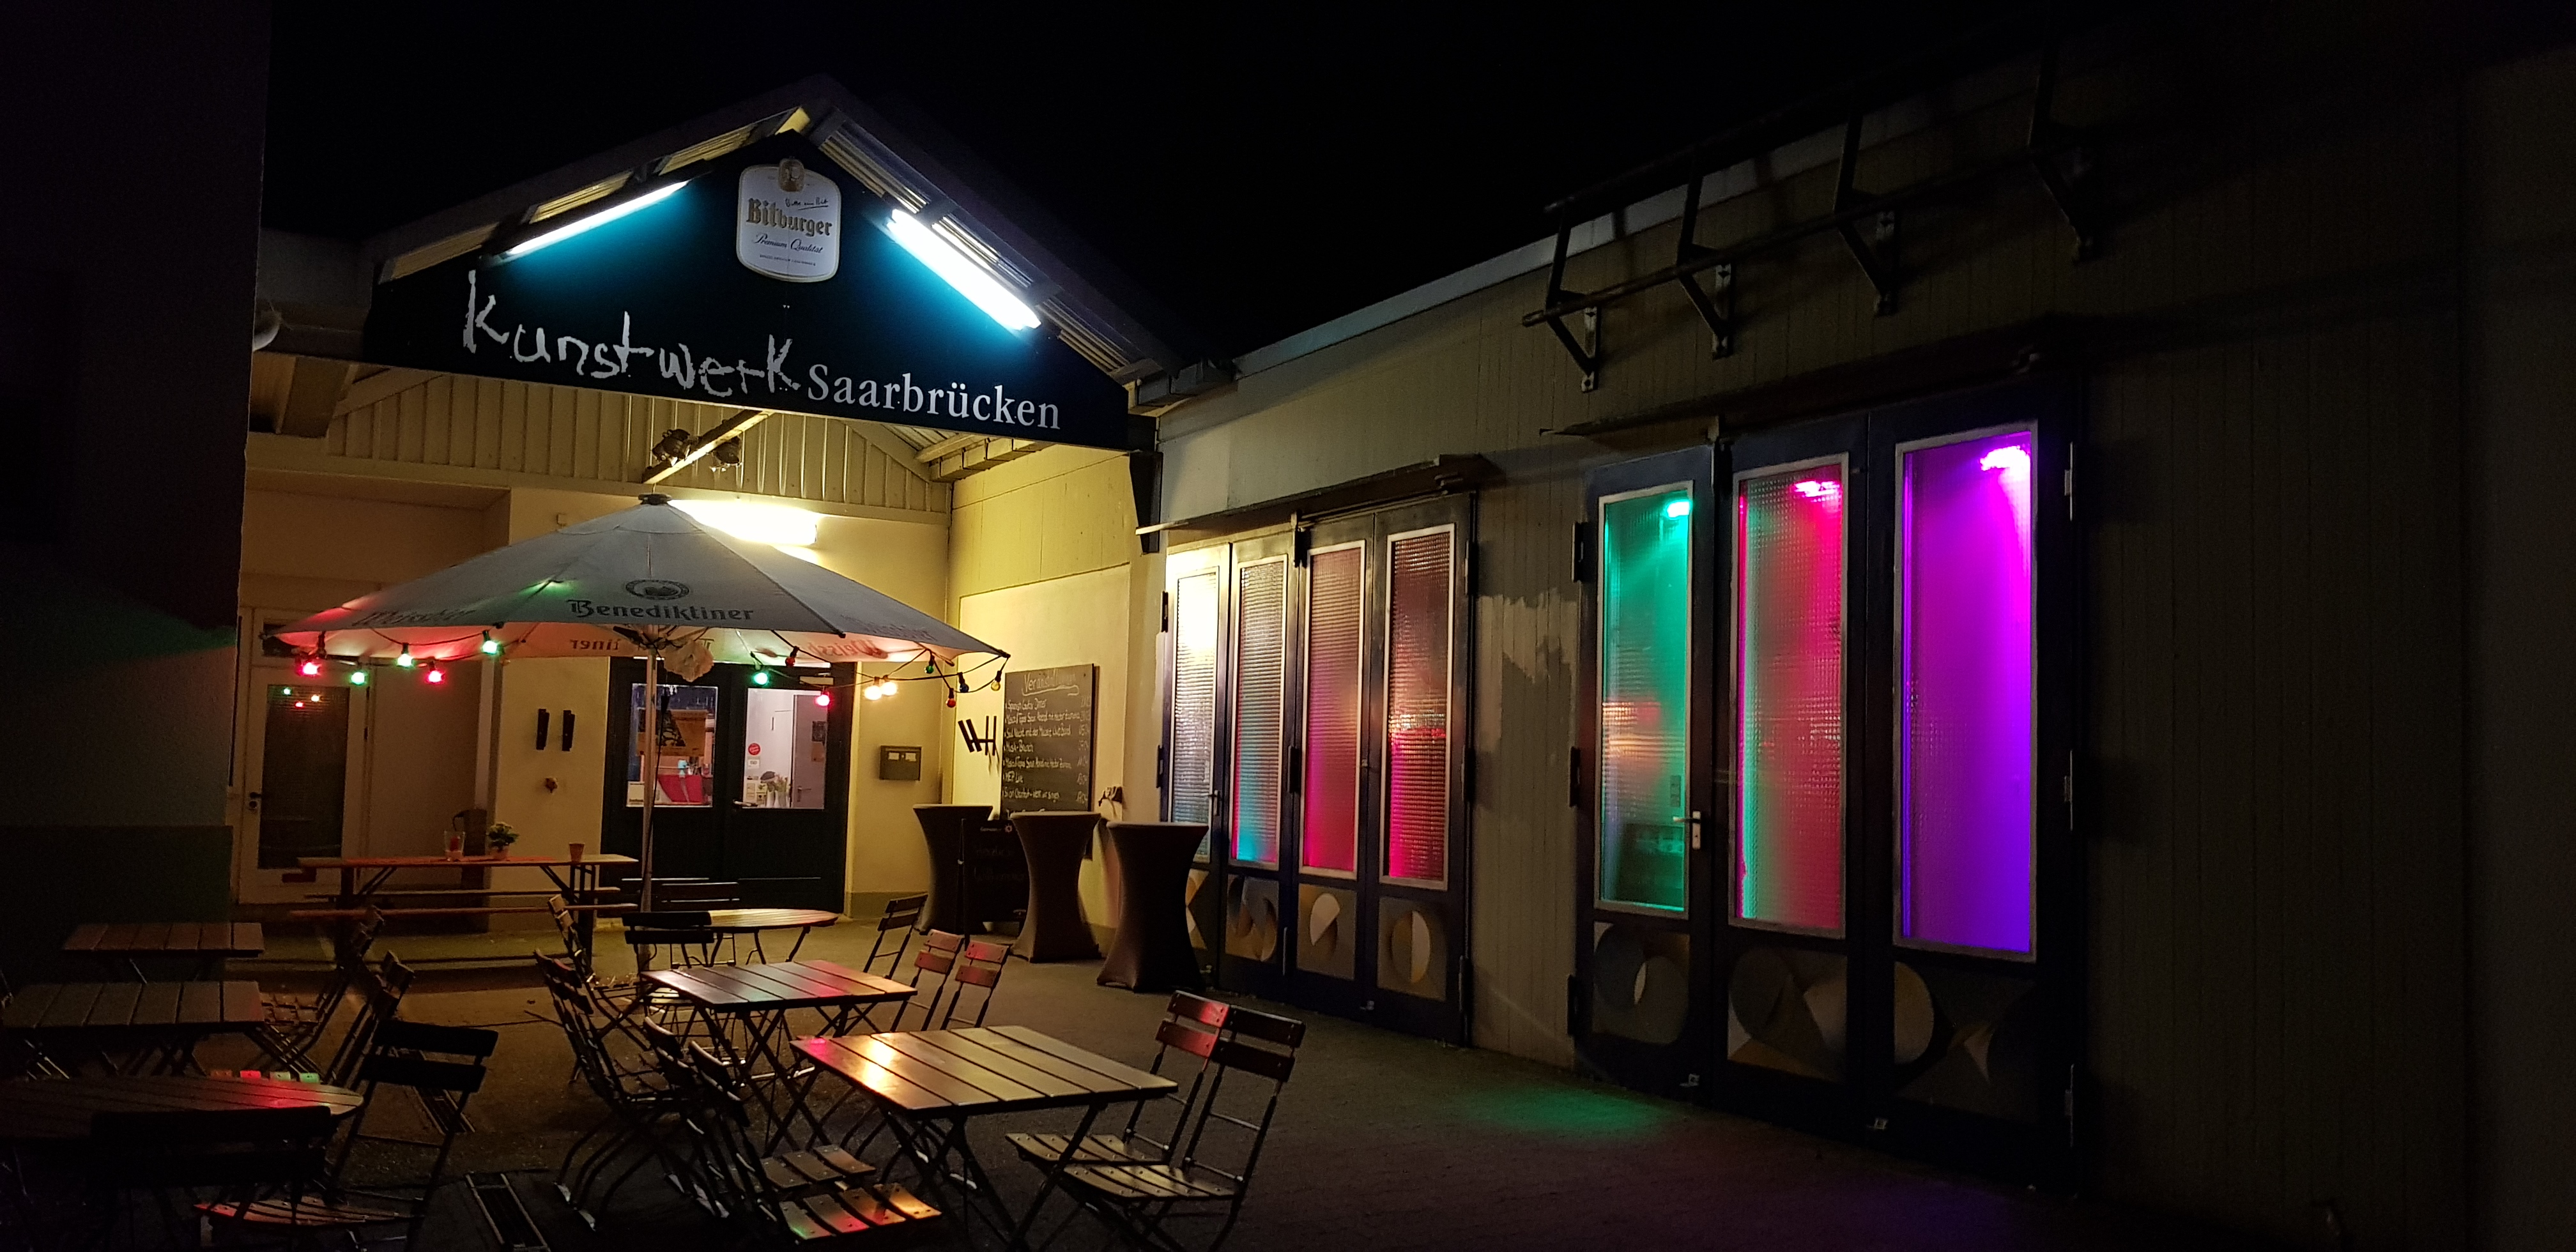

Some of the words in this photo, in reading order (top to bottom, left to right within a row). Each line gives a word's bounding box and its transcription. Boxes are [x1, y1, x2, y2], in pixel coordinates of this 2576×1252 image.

[746, 198, 832, 237] Bitburger
[753, 233, 787, 248] Premium
[808, 363, 1061, 430] Saarbrücken
[566, 599, 754, 620] Benediktiner
